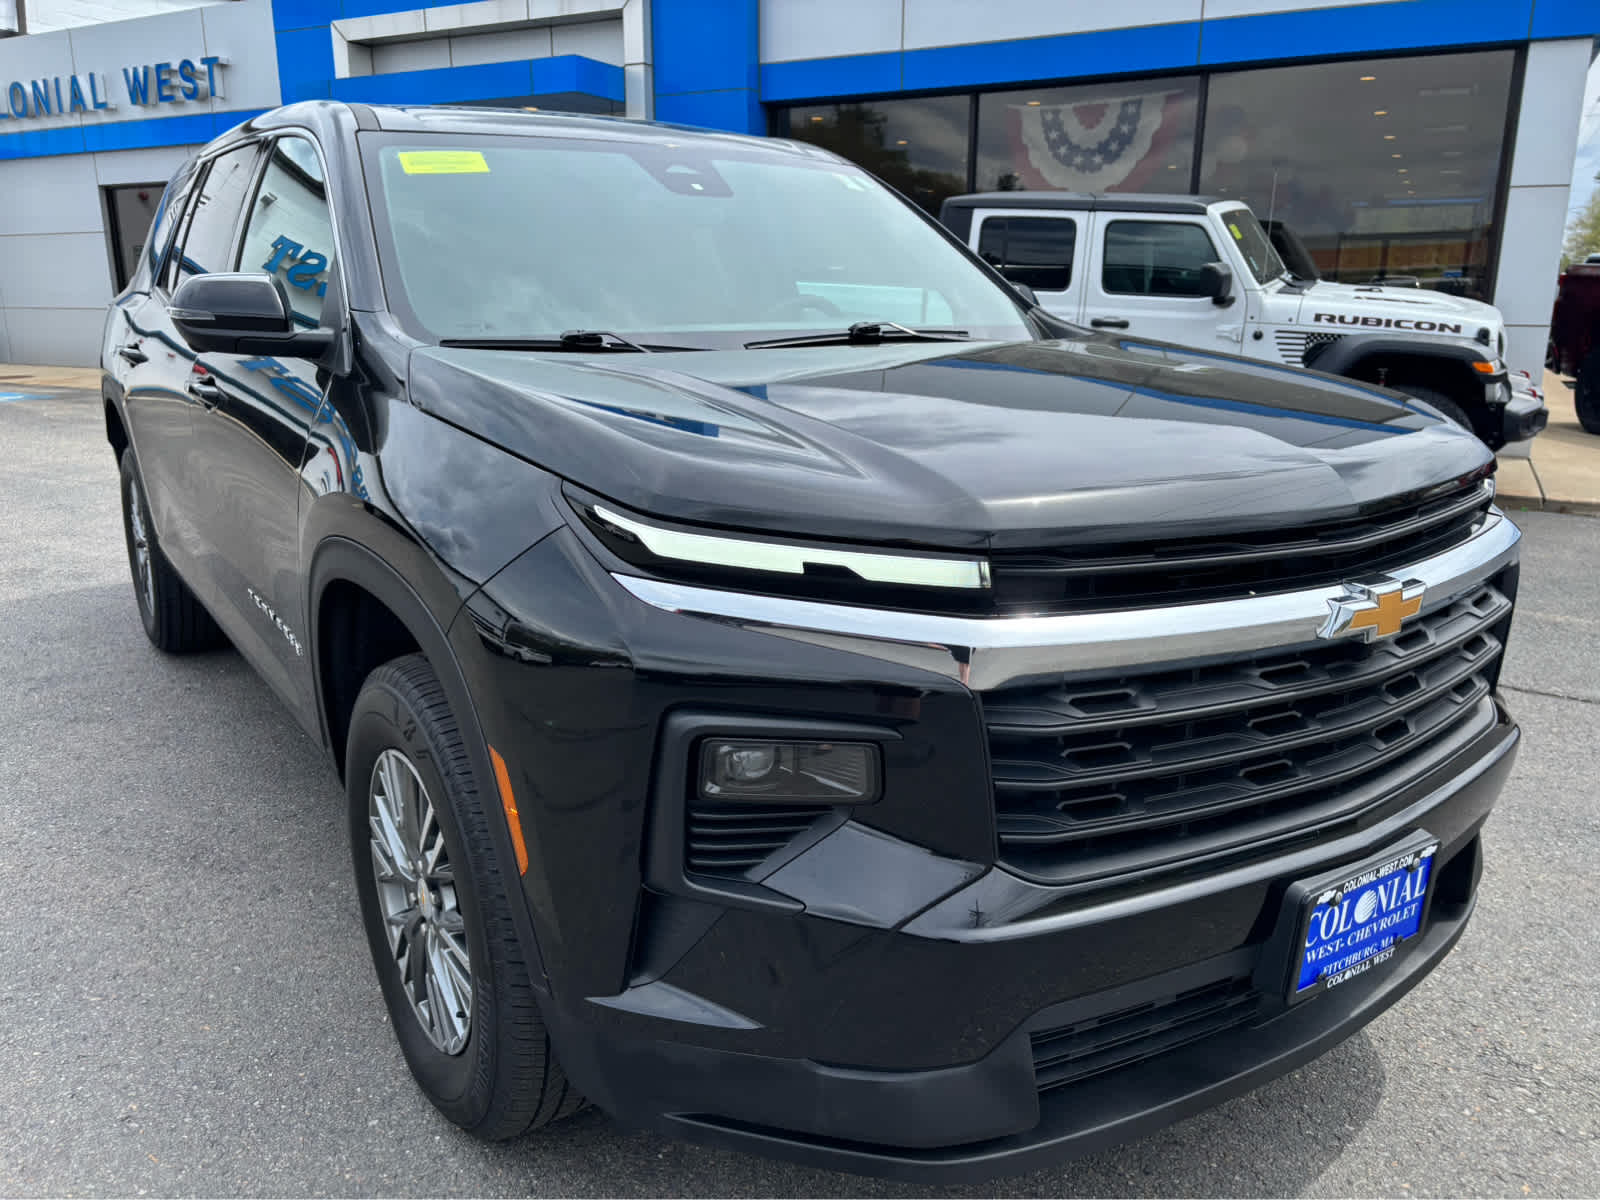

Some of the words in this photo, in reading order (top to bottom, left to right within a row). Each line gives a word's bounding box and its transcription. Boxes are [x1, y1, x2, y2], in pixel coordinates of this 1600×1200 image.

[122, 56, 219, 105] WEST
[1313, 312, 1462, 334] RUBICON
[1343, 853, 1415, 893] COLONIAL-WEST.COM
[1347, 902, 1418, 946] CHEVROLET
[1373, 947, 1396, 966] WEST
